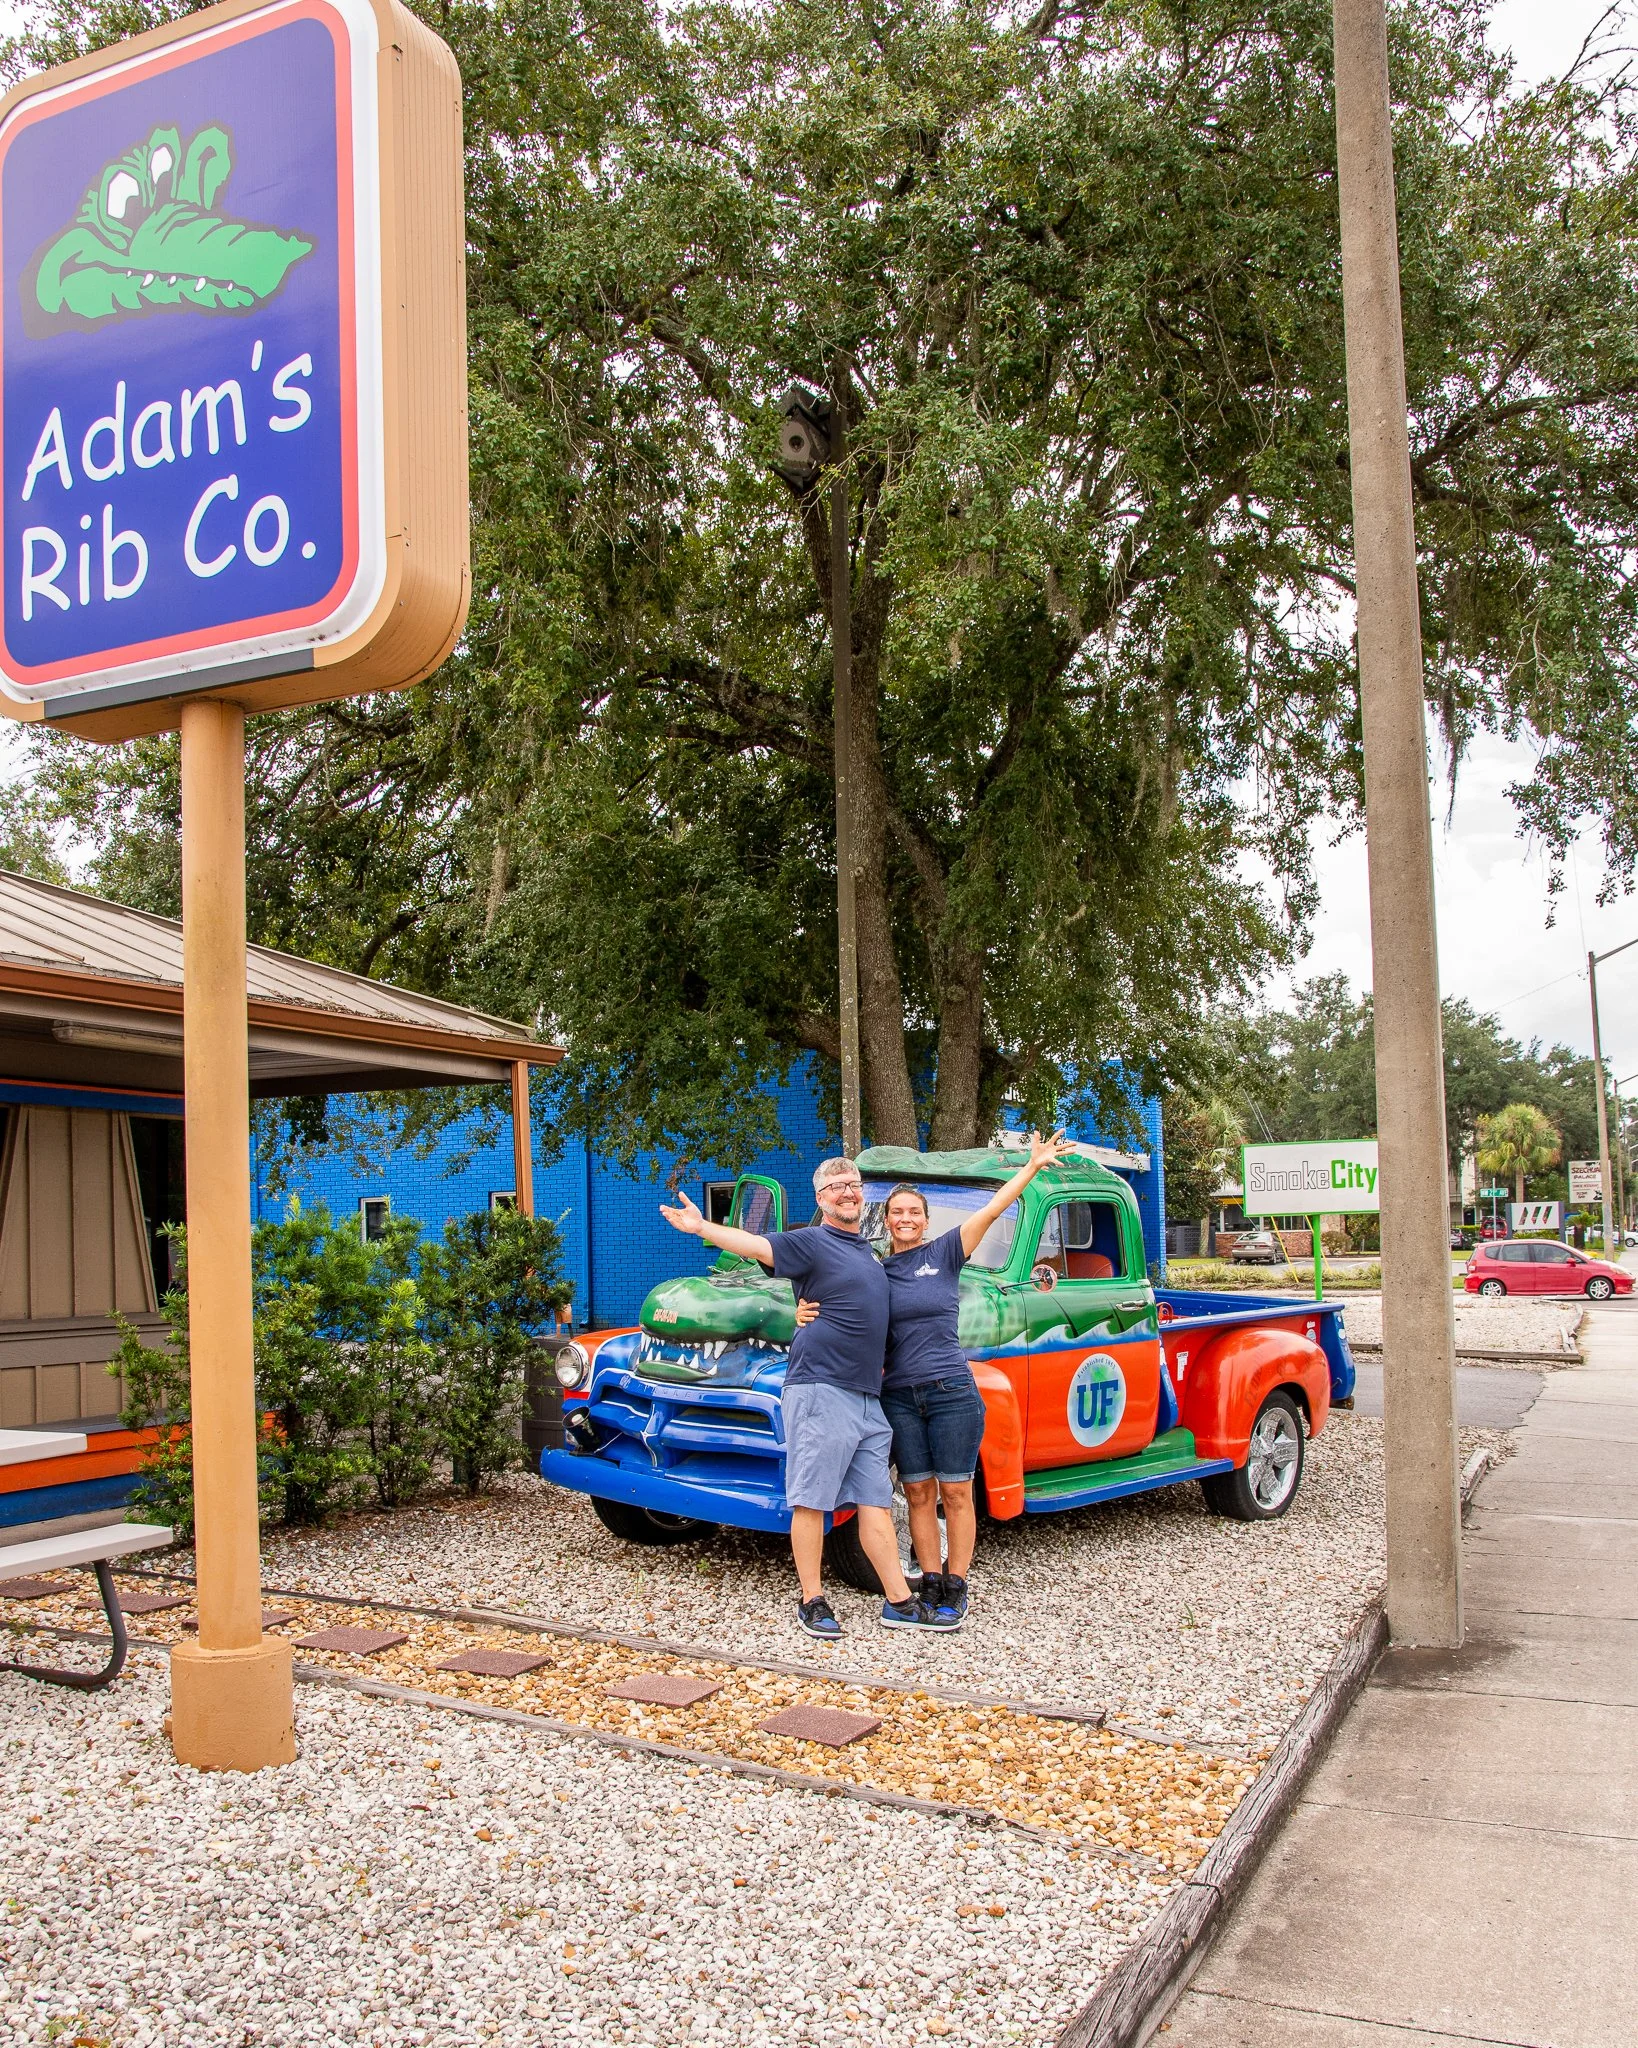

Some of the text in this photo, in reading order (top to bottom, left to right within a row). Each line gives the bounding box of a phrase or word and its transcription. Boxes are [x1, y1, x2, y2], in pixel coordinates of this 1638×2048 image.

[20, 339, 314, 502] Adam's
[21, 474, 317, 622] Rib Co.
[1250, 1159, 1378, 1194] SmokeCity
[1077, 1379, 1119, 1429] UF
